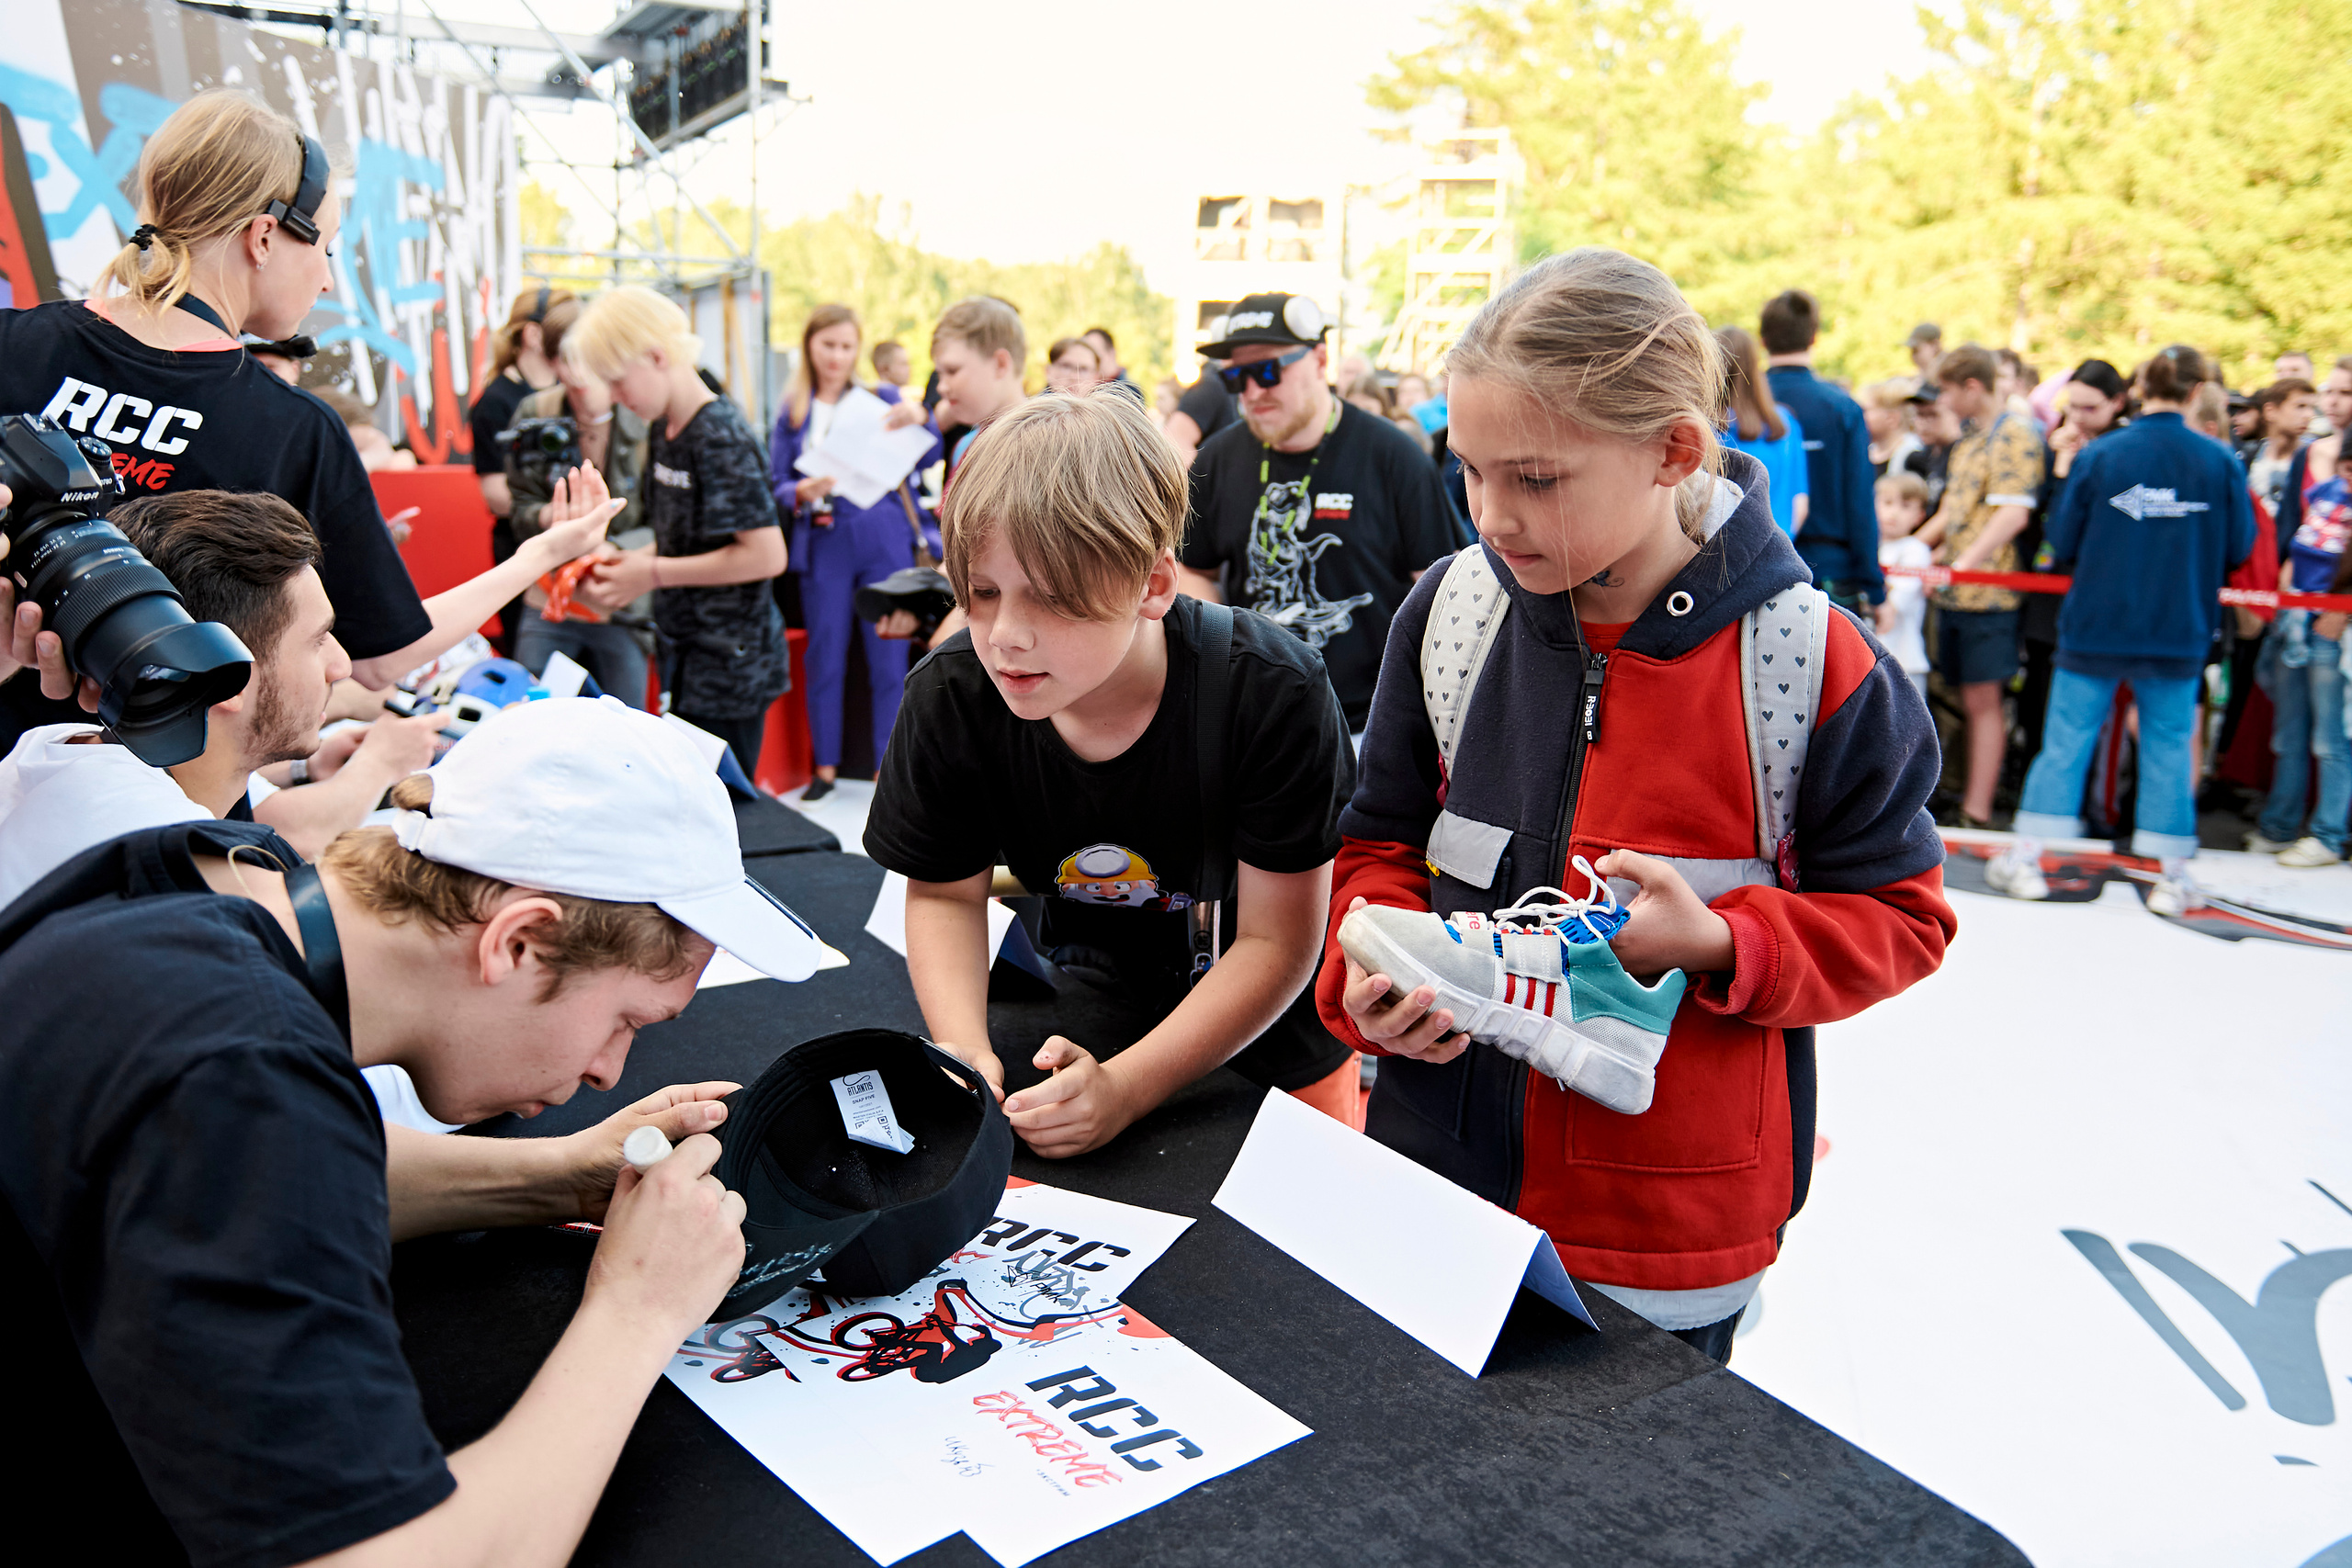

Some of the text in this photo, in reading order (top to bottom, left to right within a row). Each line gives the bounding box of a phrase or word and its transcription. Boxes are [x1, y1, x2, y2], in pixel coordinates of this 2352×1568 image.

[40, 376, 204, 456] RCC
[61, 491, 100, 503] Nikon
[110, 452, 175, 491] EME
[847, 1081, 874, 1096] ATLANTIS
[980, 1215, 1132, 1272] RCC
[972, 1390, 1124, 1488] EXTREME
[1024, 1364, 1204, 1472] RCC
